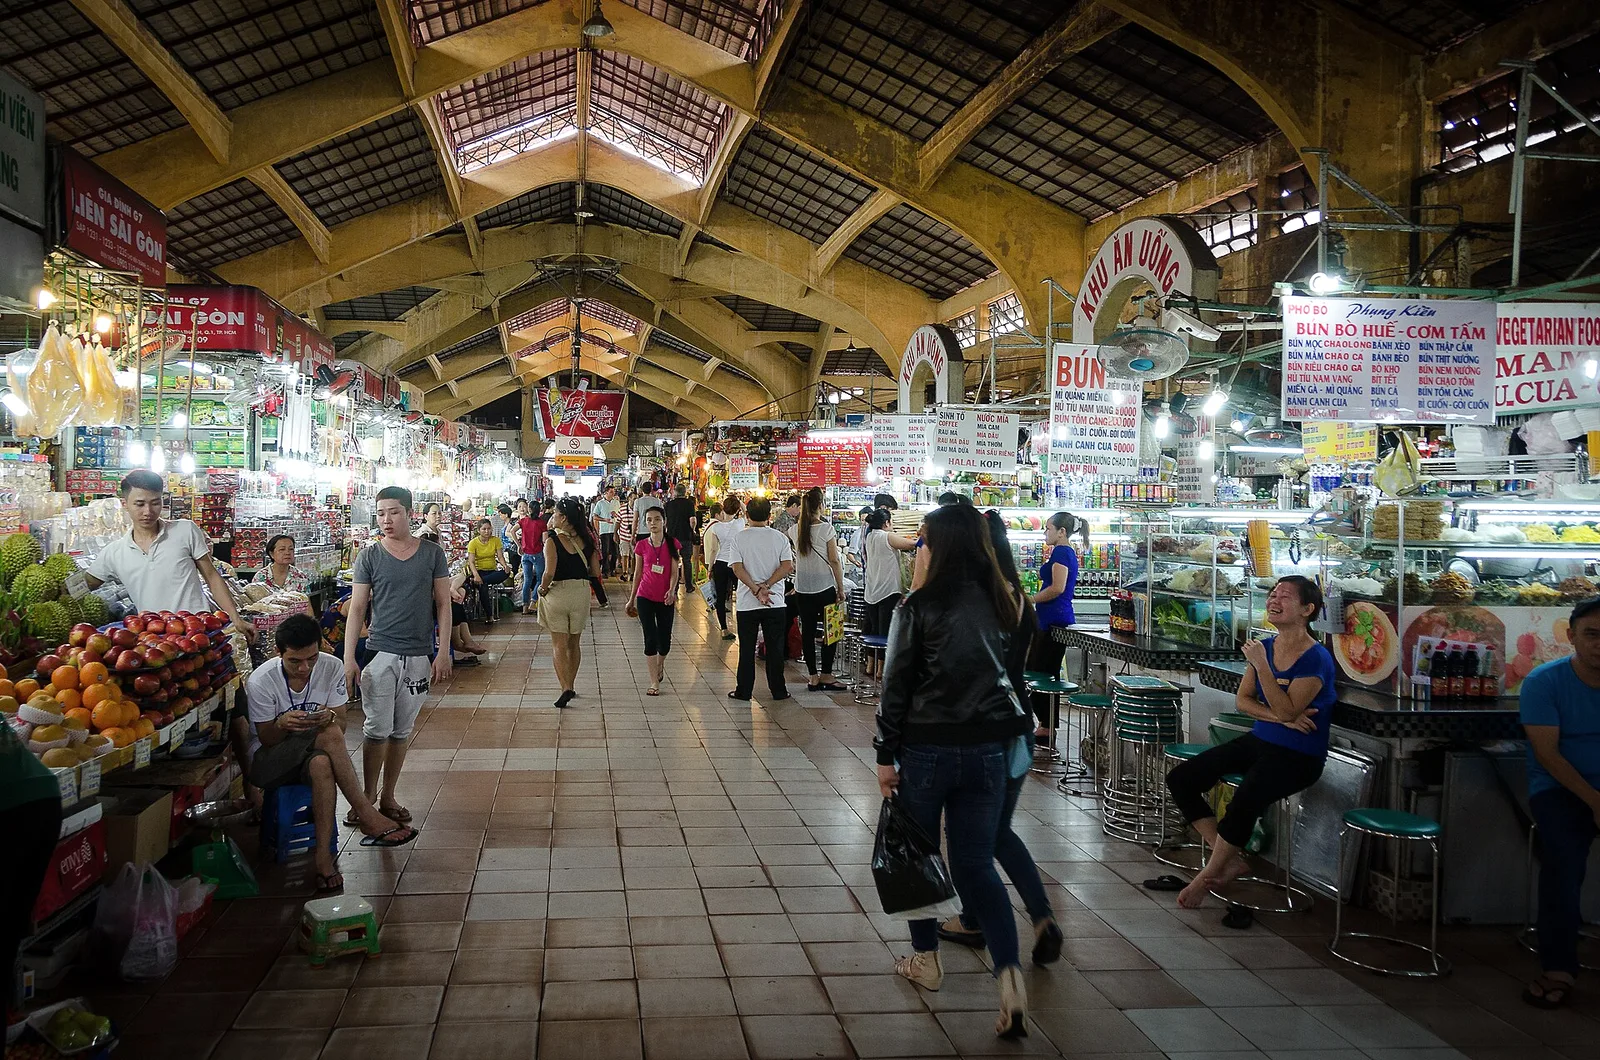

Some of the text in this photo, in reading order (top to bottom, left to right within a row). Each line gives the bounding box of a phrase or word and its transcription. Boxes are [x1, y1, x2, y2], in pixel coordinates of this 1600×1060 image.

[0, 150, 19, 193] NG
[98, 187, 113, 206] GIA
[133, 210, 144, 224] G7
[72, 187, 162, 264] LIÊN SÀI GÒN
[1080, 228, 1180, 323] KHU ĂN UỐNG
[188, 297, 210, 306] G7
[190, 308, 245, 326] GÒN
[1346, 304, 1437, 320] Phụng Kiều
[1296, 318, 1486, 340] BÚN BÒ HUẾ CƠM TẤM
[1496, 317, 1574, 346] VEGETARIAN
[1288, 338, 1323, 350] BÚN MỌC
[1372, 340, 1411, 350] BÁNH XÈO
[1419, 340, 1434, 350] BÚN
[1436, 342, 1454, 353] THẬP
[902, 332, 944, 386] KHU ĂN UỐNG
[1288, 350, 1303, 360] BÚN
[1324, 350, 1364, 361] CHÁO CÁ
[1372, 352, 1410, 362] BÁNH BÈO
[1418, 353, 1480, 365] BÚN THỊT NƯỚNG
[1056, 349, 1106, 390] BÚN
[1288, 361, 1322, 372] BÚN RIÊU
[1324, 362, 1362, 372] CHÁO GÀ
[1372, 364, 1400, 374] BÒ KHO
[1418, 364, 1481, 376] BÚN NEM NƯỚNG
[1288, 372, 1353, 384] HỦ TÍU NAM VANG
[1372, 374, 1396, 384] BÍT TẾT
[1418, 376, 1475, 388] BÚN CHẠO TÔM
[1121, 382, 1132, 392] CUA
[1286, 383, 1363, 396] MIẾN GÀ MÌ QUẢNG
[1371, 385, 1399, 396] BÚN CÁ
[1418, 386, 1474, 398] BÚN TÔM CÀNG
[1055, 389, 1064, 400] MÌ
[1064, 388, 1085, 401] QUẢNG
[1287, 396, 1348, 407] BÁNH CANH CUA
[1371, 398, 1400, 408] TÔM SÚ
[1418, 398, 1426, 409] BÌ
[1426, 398, 1449, 409] CUỐN
[1468, 398, 1490, 410] CUỐN
[1054, 400, 1064, 412] HỦ
[1078, 403, 1094, 413] NAM
[1096, 404, 1114, 414] VANG
[1114, 407, 1137, 418] 50000
[939, 411, 966, 421] SINH TỐ
[976, 412, 1009, 424] NƯỚC MÍA
[1054, 413, 1108, 426] BÚN TÔM CÀNG
[986, 440, 1003, 448] THƠM
[1076, 440, 1135, 453] CANH CUA 50000
[876, 463, 894, 476] CHÈ
[900, 463, 915, 476] SÀI
[948, 458, 1002, 469] HALAL KOPI
[60, 848, 83, 876] envy
